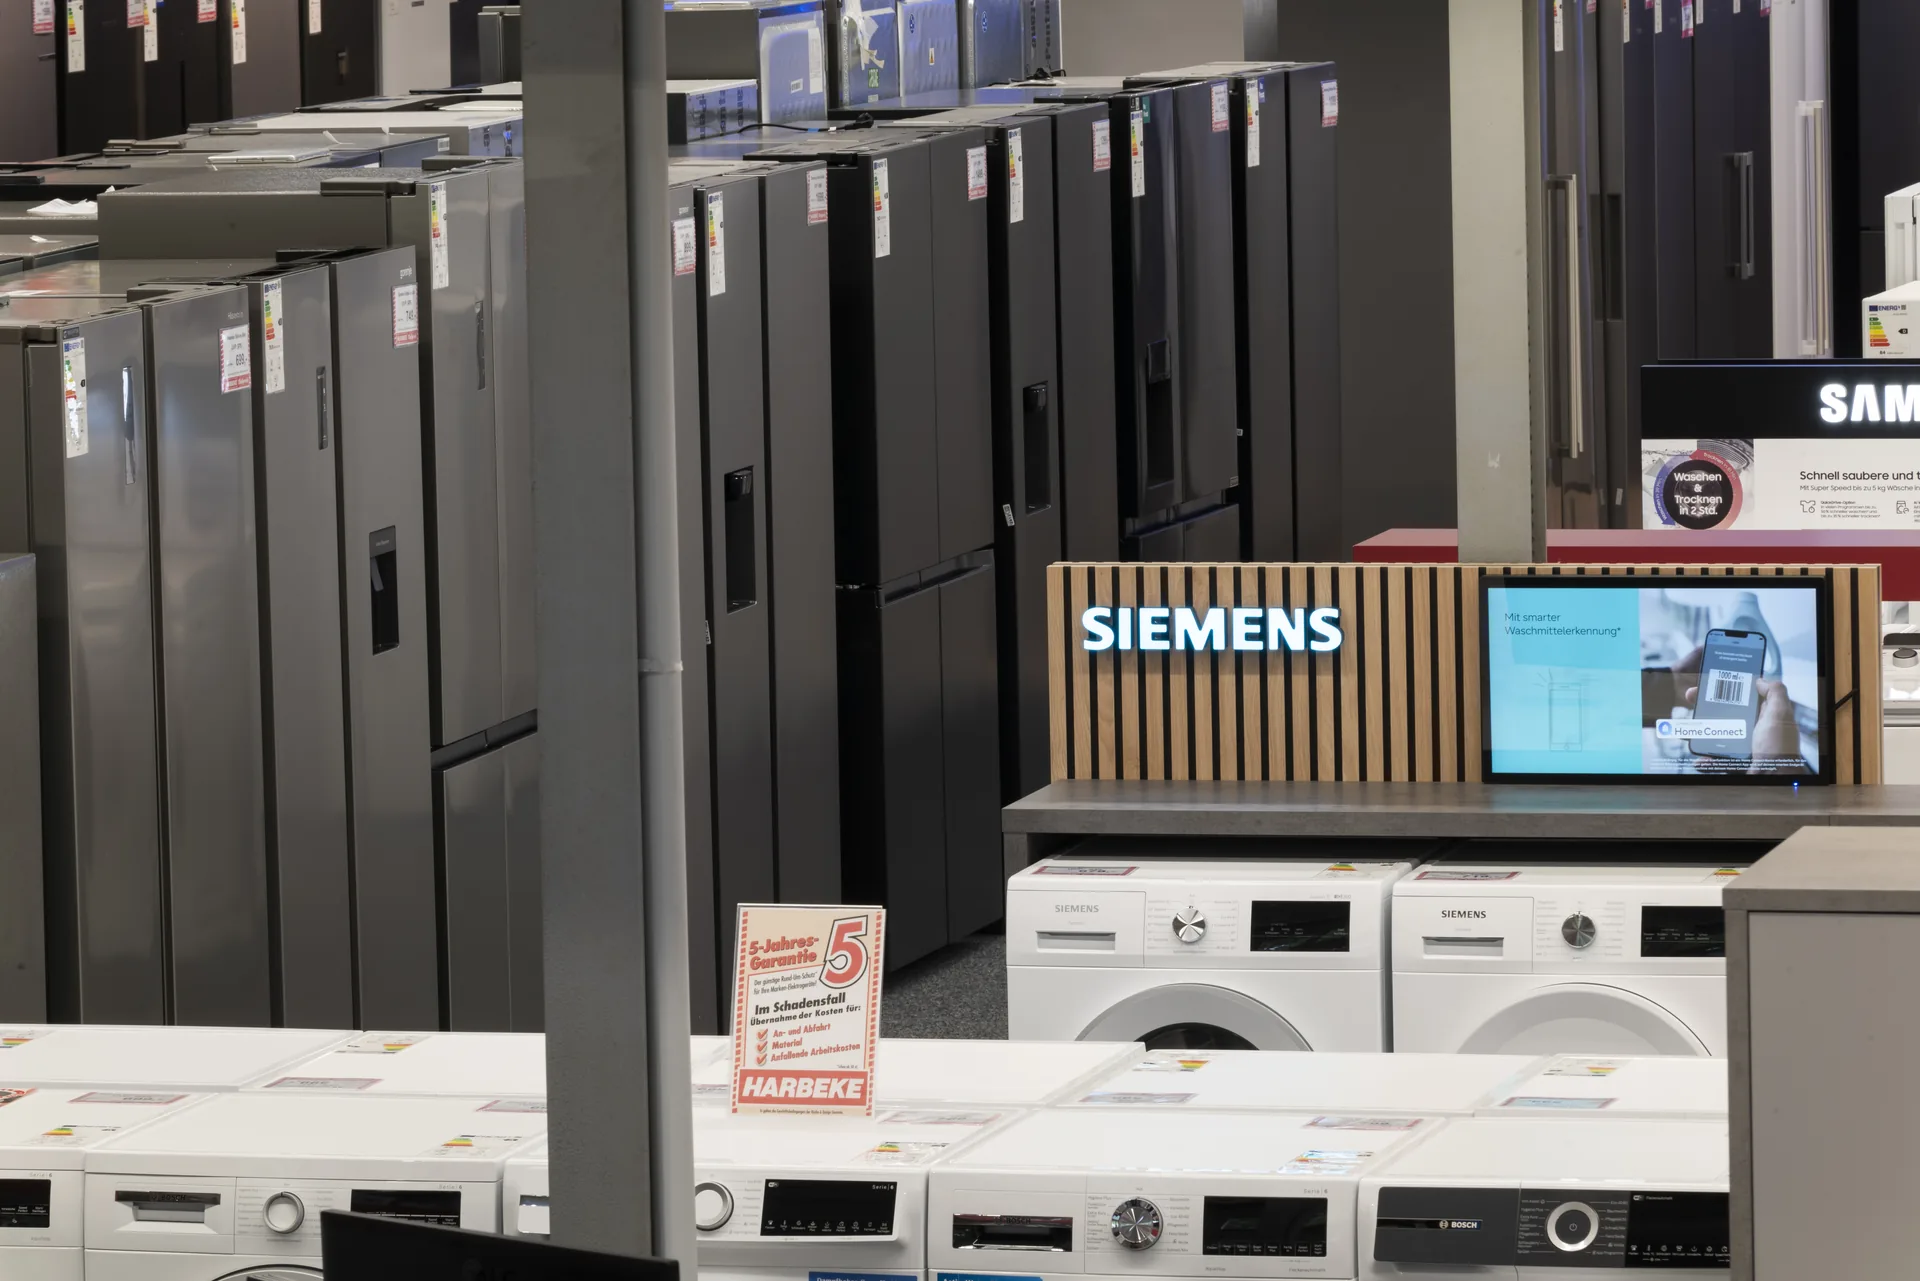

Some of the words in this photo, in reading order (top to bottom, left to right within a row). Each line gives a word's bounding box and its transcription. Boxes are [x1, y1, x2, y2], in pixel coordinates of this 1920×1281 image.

[1674, 472, 1722, 481] Waschen
[1800, 471, 1840, 480] Schnell
[1842, 471, 1889, 480] saubere
[1892, 471, 1914, 480] und
[1693, 483, 1702, 492] &
[1674, 495, 1723, 504] Trocknen
[1680, 506, 1689, 515] in
[1690, 506, 1697, 515] 2
[1699, 506, 1718, 515] Std.
[1504, 613, 1521, 622] Mit
[1523, 614, 1561, 622] smarter
[1081, 606, 1343, 651] SIEMENS
[1718, 670, 1731, 679] 1000
[1674, 727, 1703, 736] Home
[1704, 727, 1743, 736] Connect
[1055, 905, 1100, 913] SIEMENS
[1441, 910, 1487, 919] SIEMENS
[749, 936, 820, 955] 5-Jahres-
[819, 915, 868, 989] 5
[750, 949, 818, 970] Garantie
[755, 1005, 770, 1015] Im
[773, 992, 846, 1013] Schadensfall
[750, 1014, 797, 1026] Übernahme
[798, 1011, 813, 1019] der
[815, 1007, 844, 1017] Kosten
[846, 1004, 862, 1013] für:
[772, 1030, 786, 1038] An-
[788, 1026, 802, 1035] und
[803, 1023, 831, 1034] Abfahrt
[772, 1037, 803, 1050] Material
[771, 1049, 809, 1062] Anfallende
[810, 1043, 861, 1056] Arbeitskosten
[742, 1076, 865, 1099] HARBEKE
[1451, 1221, 1477, 1229] BOSCH
